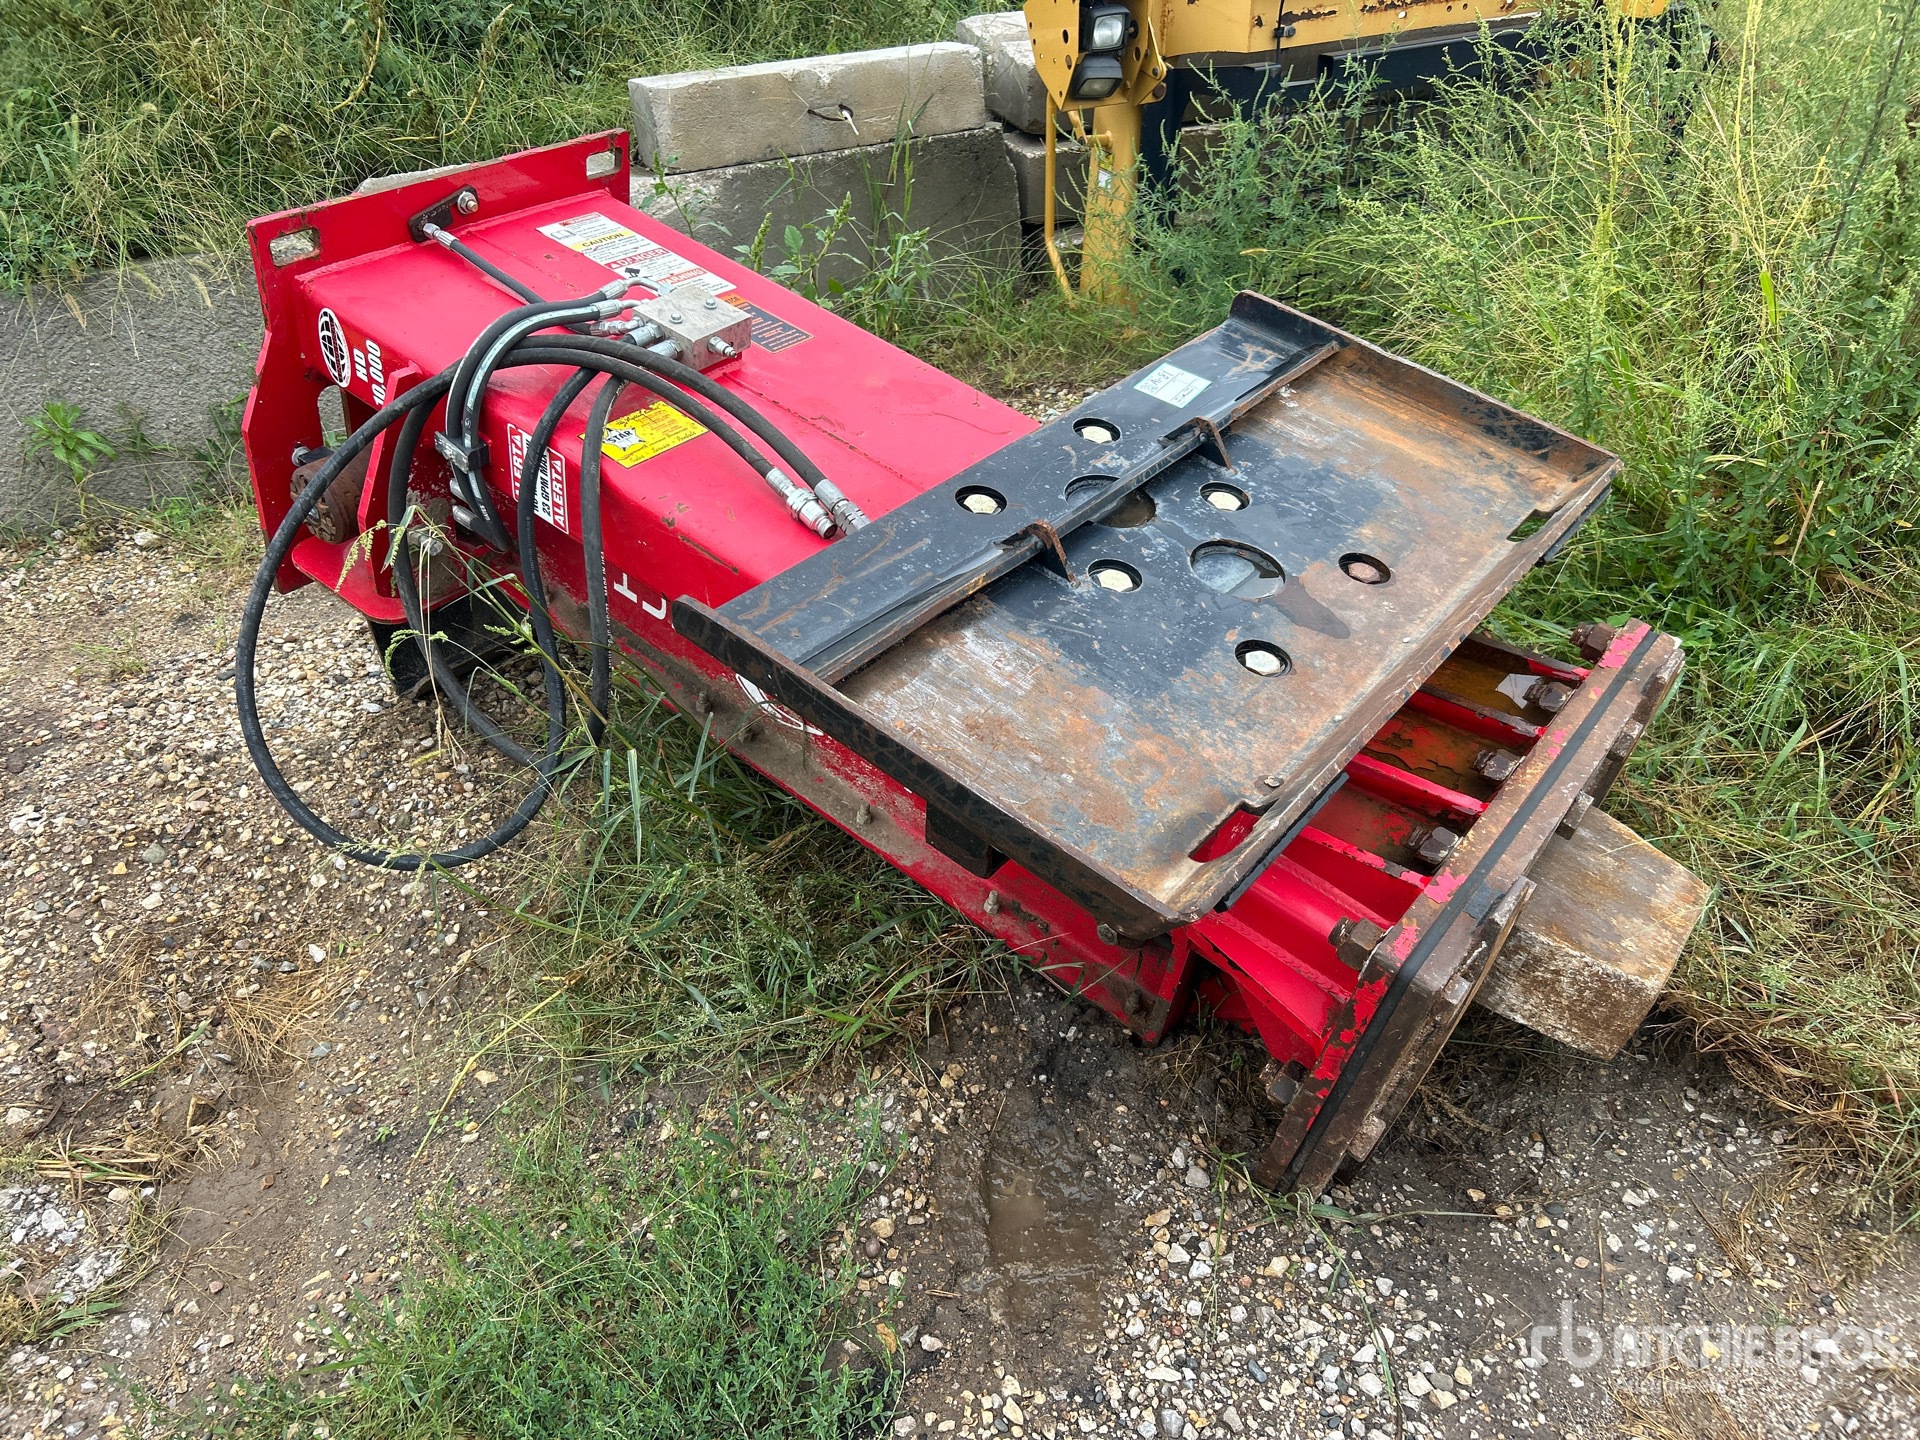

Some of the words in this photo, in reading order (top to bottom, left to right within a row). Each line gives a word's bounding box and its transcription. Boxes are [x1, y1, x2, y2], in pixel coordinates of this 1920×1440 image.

[582, 232, 624, 248] CAUTION
[617, 248, 667, 267] DANGER
[353, 347, 368, 383] HD
[365, 339, 387, 406] 10,000
[608, 429, 632, 444] STAR
[540, 476, 551, 502] GPM
[551, 467, 565, 528] ALERT
[542, 502, 552, 517] 23
